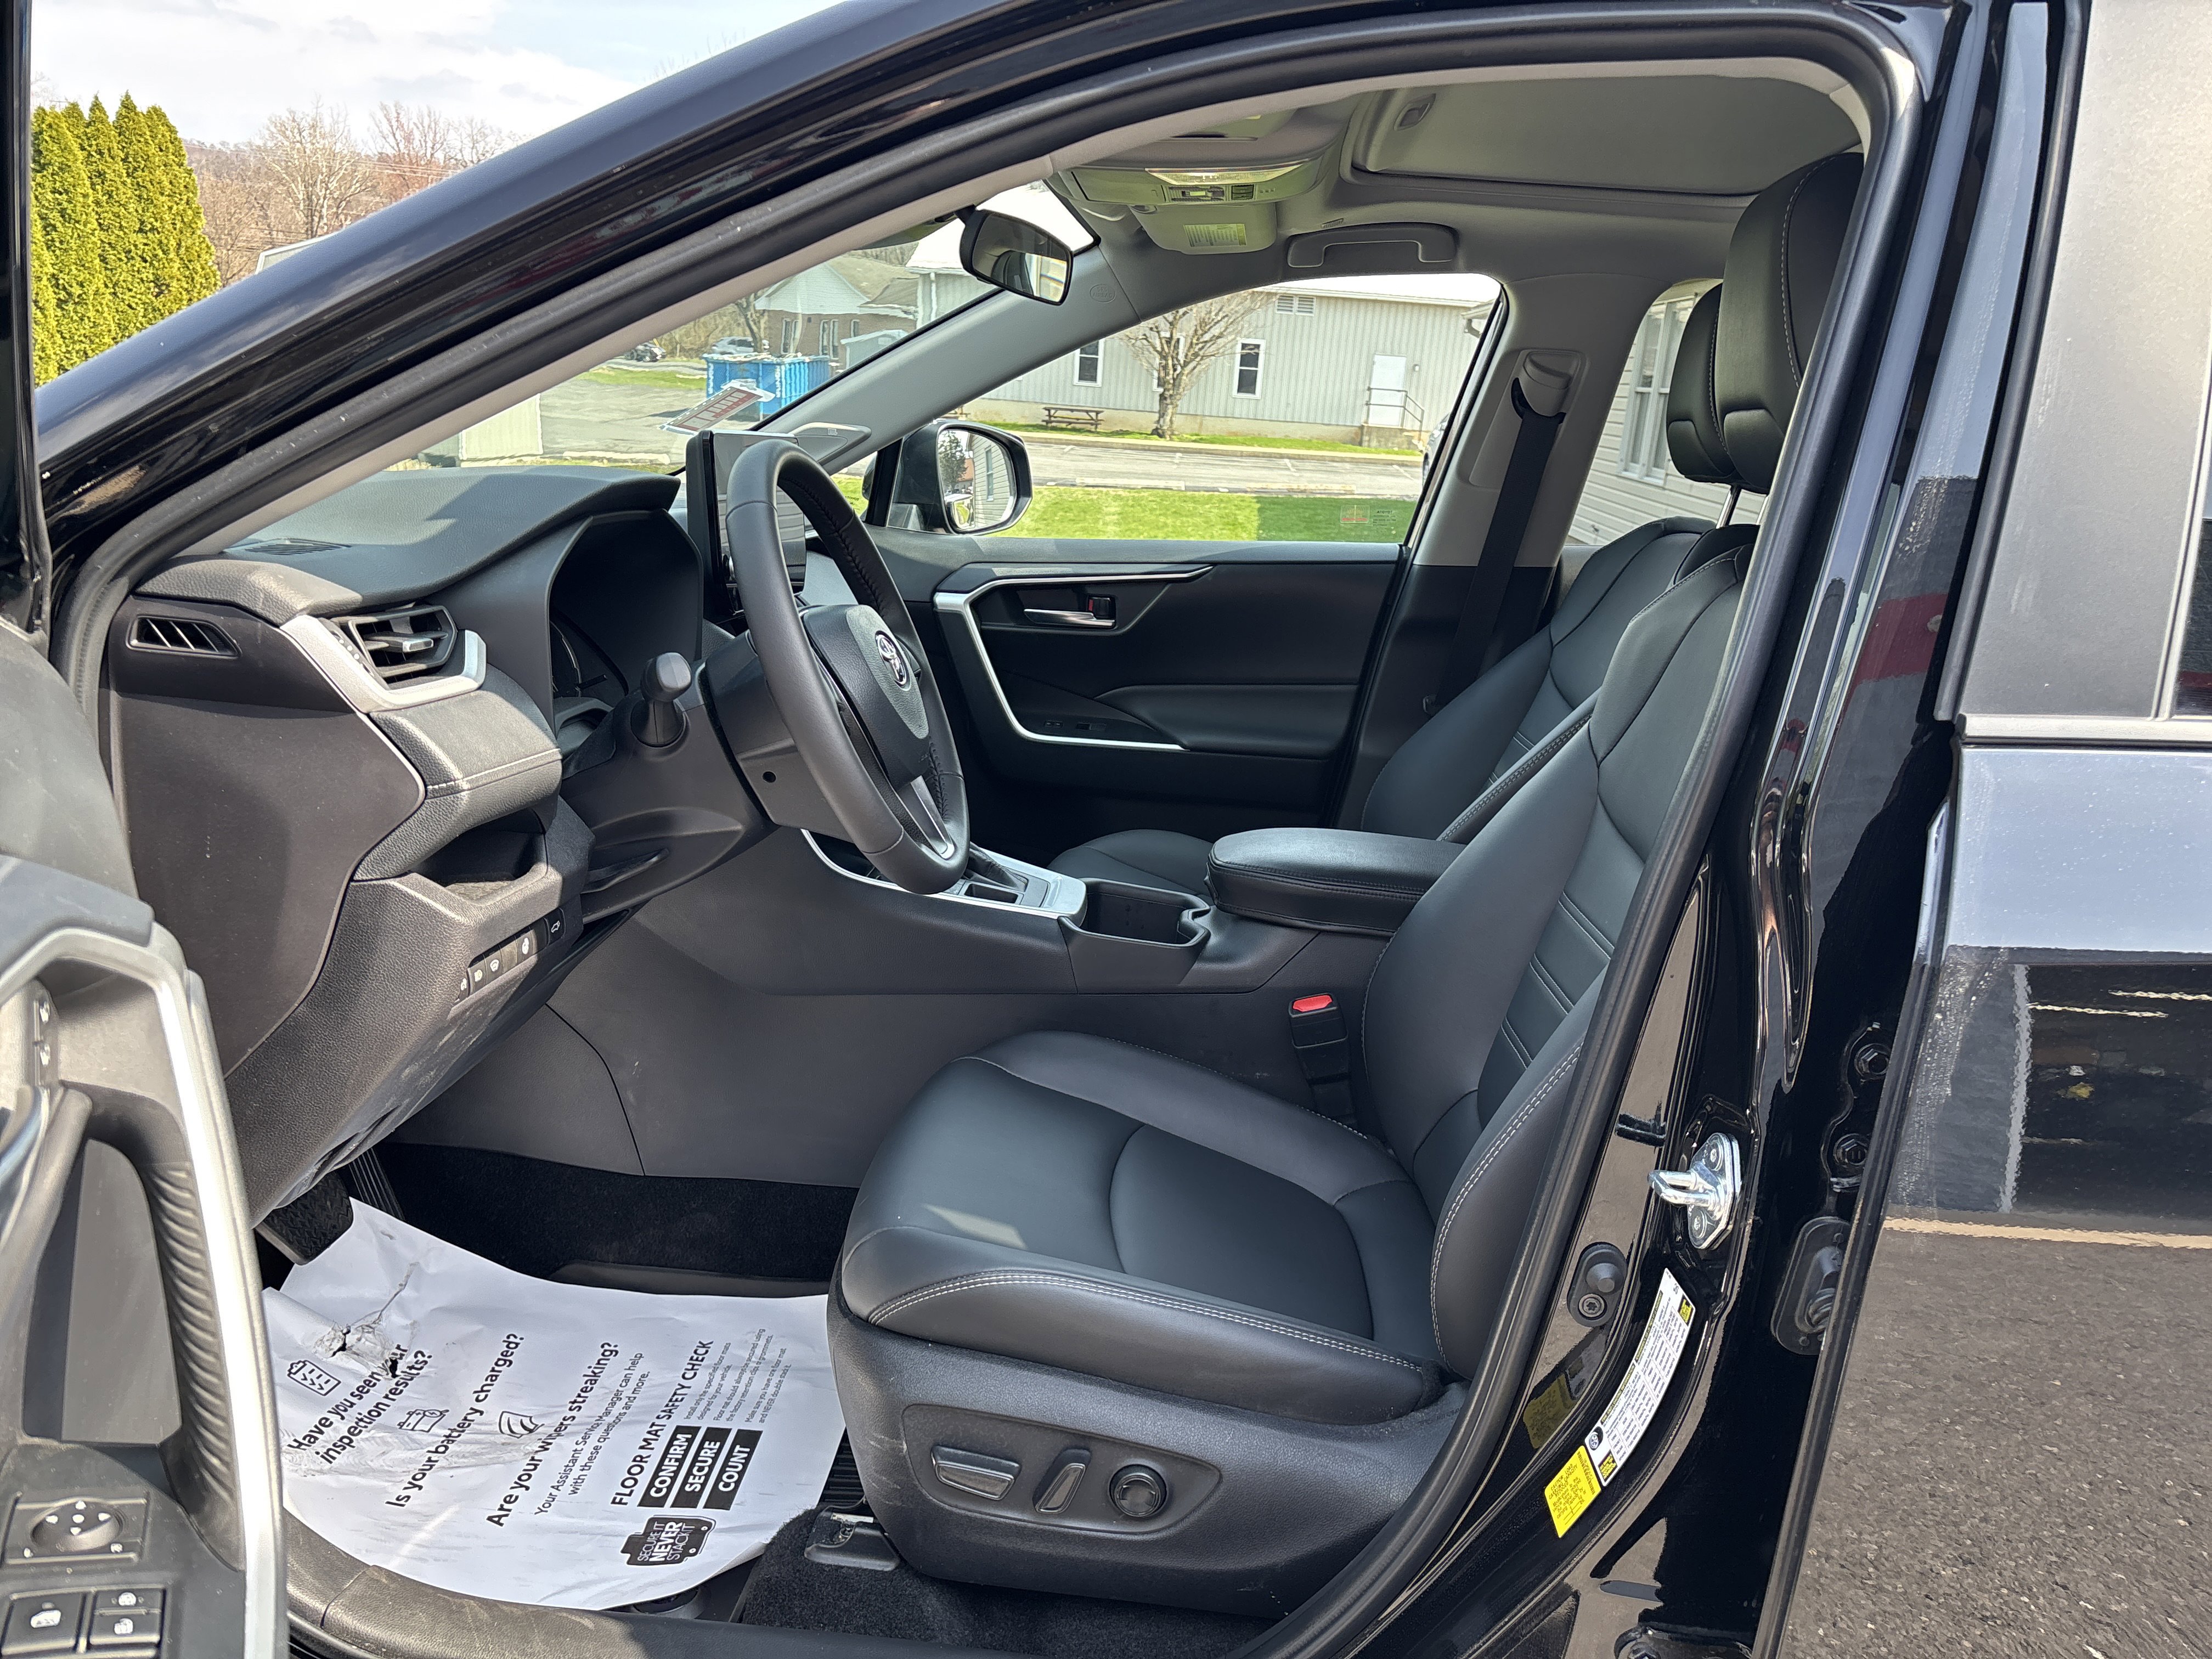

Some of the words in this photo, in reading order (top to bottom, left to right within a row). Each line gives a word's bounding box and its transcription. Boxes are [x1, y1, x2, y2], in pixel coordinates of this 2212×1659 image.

[619, 1368, 633, 1388] can
[624, 1352, 644, 1371] help
[287, 1417, 334, 1451] Have
[327, 1398, 357, 1421] you
[349, 1371, 382, 1401] seen
[315, 1401, 391, 1464] inspection
[382, 1350, 432, 1401] results?
[385, 1494, 411, 1507] Is
[402, 1456, 440, 1491] your
[426, 1407, 484, 1454] battery
[472, 1333, 524, 1402] charged?
[594, 1389, 624, 1421] Manager
[611, 1454, 651, 1505] FLOOR
[638, 1421, 667, 1451] MAT
[659, 1384, 691, 1420] SAFETY
[682, 1340, 713, 1380] CHECK
[486, 1494, 519, 1527] Are
[510, 1455, 543, 1491] your
[535, 1415, 576, 1454] wipers
[568, 1342, 619, 1412] streaking?
[569, 1474, 587, 1496] with
[580, 1445, 602, 1472] these
[597, 1412, 627, 1443] quesons
[622, 1396, 636, 1410] and
[631, 1371, 650, 1395] more.
[550, 1449, 582, 1491] Assistant
[650, 1434, 692, 1497] CONFIRM
[685, 1441, 720, 1492] SECURE
[719, 1445, 750, 1491] COUNT
[534, 1492, 558, 1515] Your
[637, 1531, 661, 1561] SECURE
[653, 1521, 665, 1530] IT
[649, 1521, 682, 1562] NEVER
